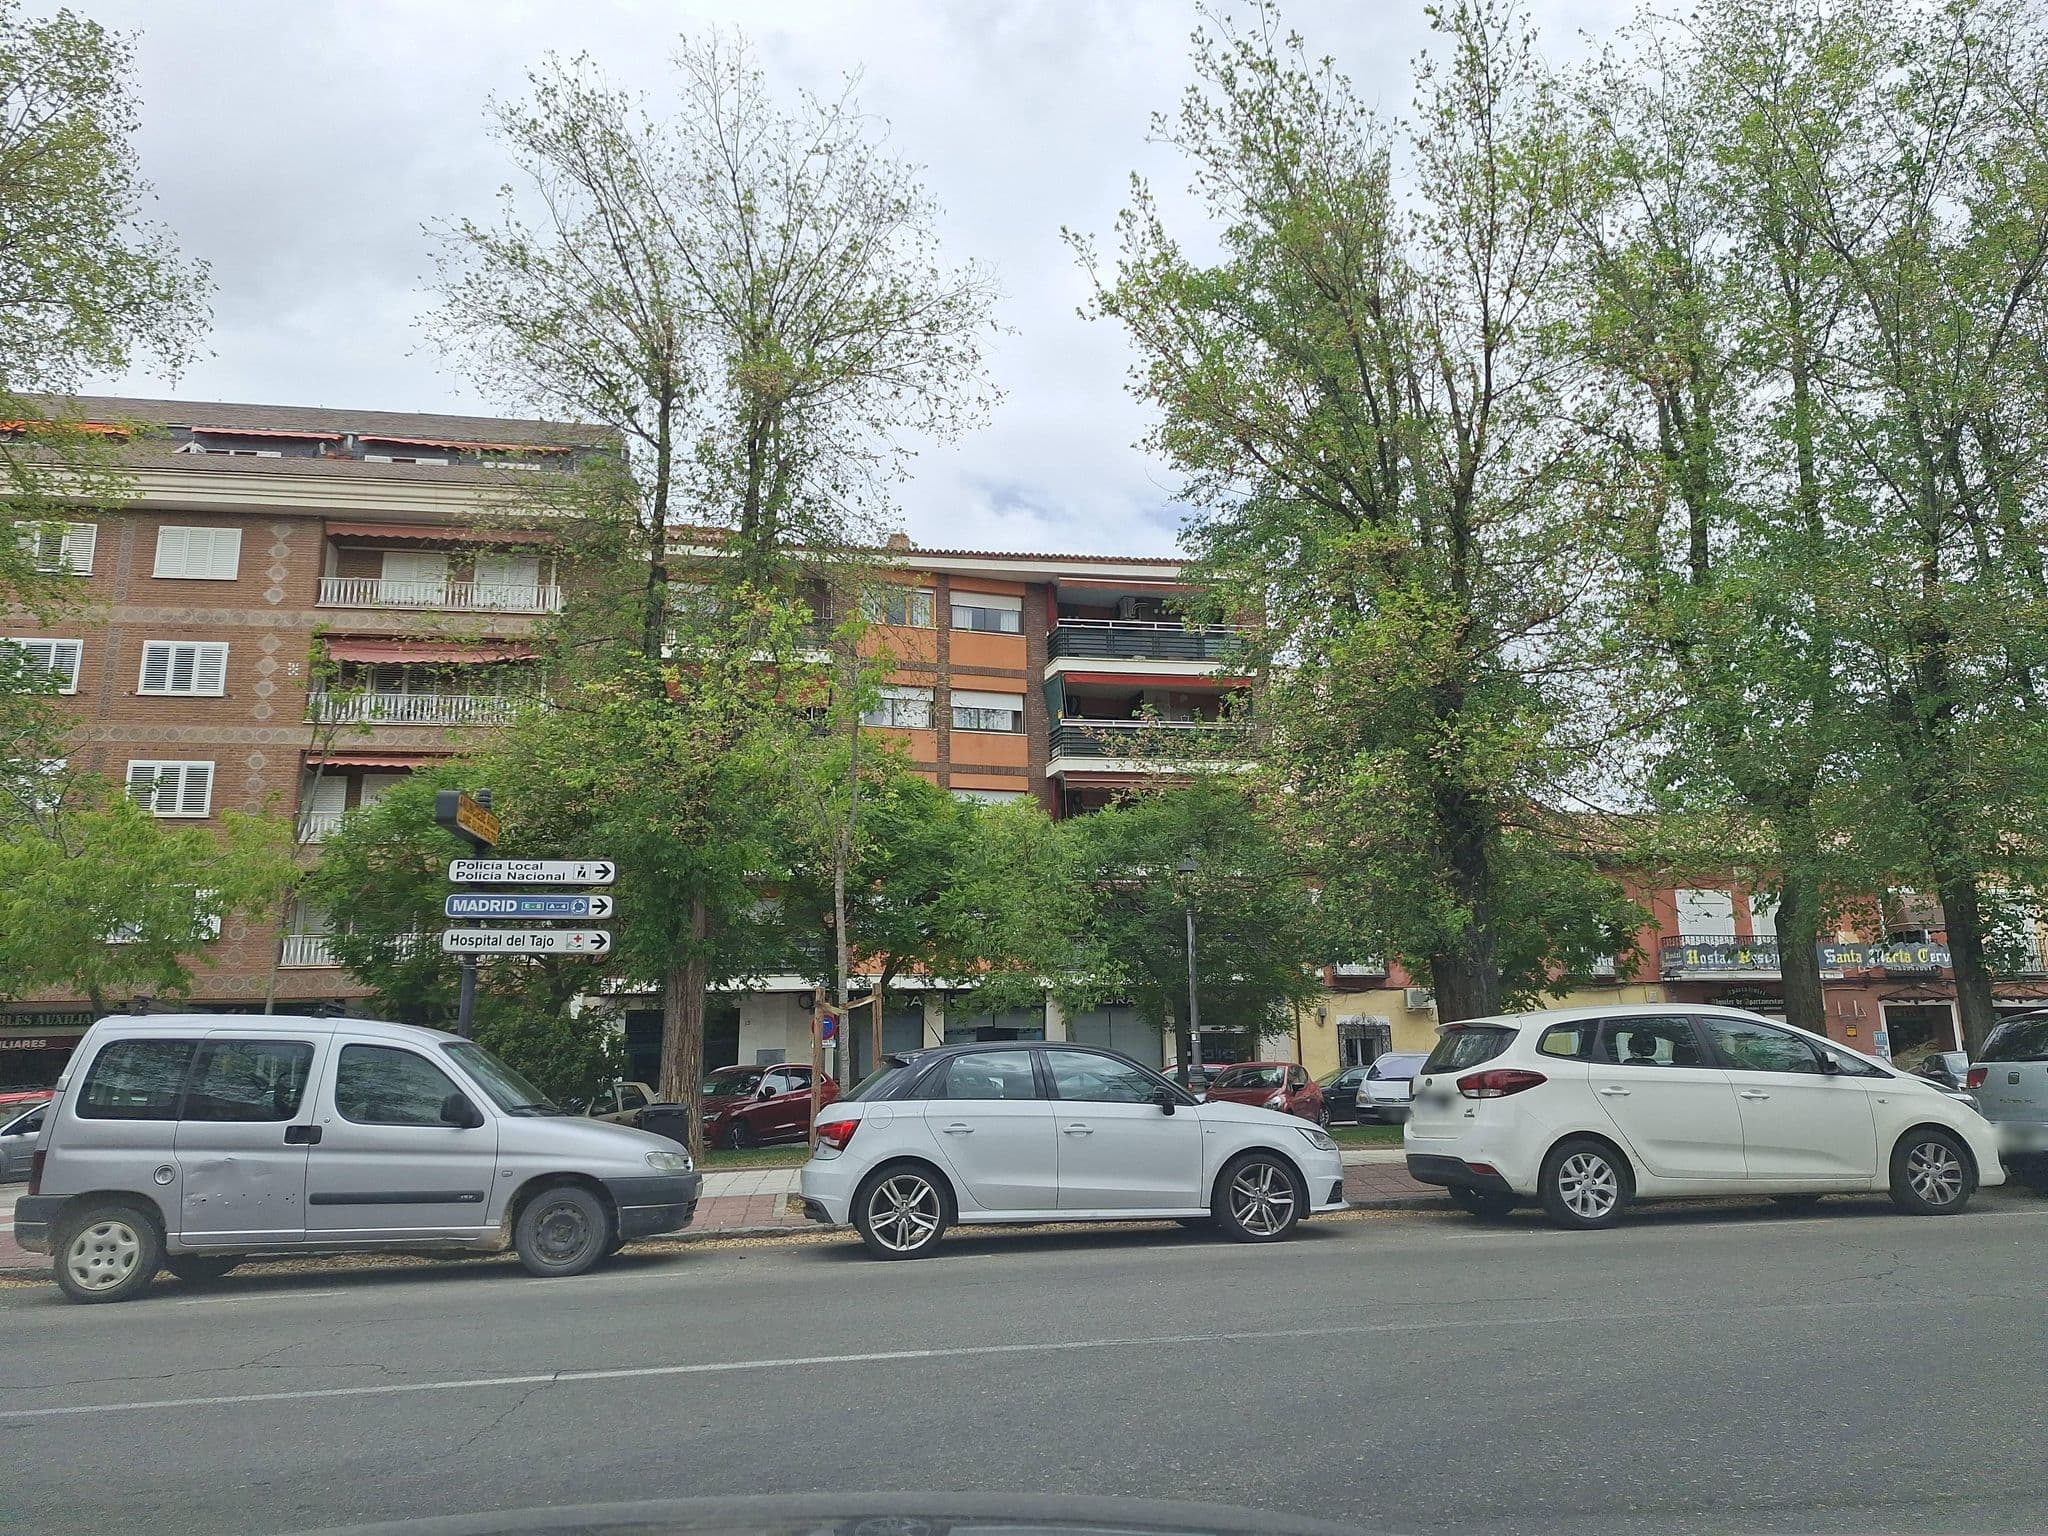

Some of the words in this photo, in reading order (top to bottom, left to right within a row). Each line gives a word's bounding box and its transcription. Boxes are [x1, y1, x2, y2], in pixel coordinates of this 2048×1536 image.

[508, 862, 543, 870] Local
[507, 873, 565, 881] Nacional
[453, 900, 517, 912] MADRID
[450, 934, 501, 948] Hospital
[506, 934, 525, 945] del
[530, 935, 554, 949] Tajo
[1824, 948, 1862, 964] Santa
